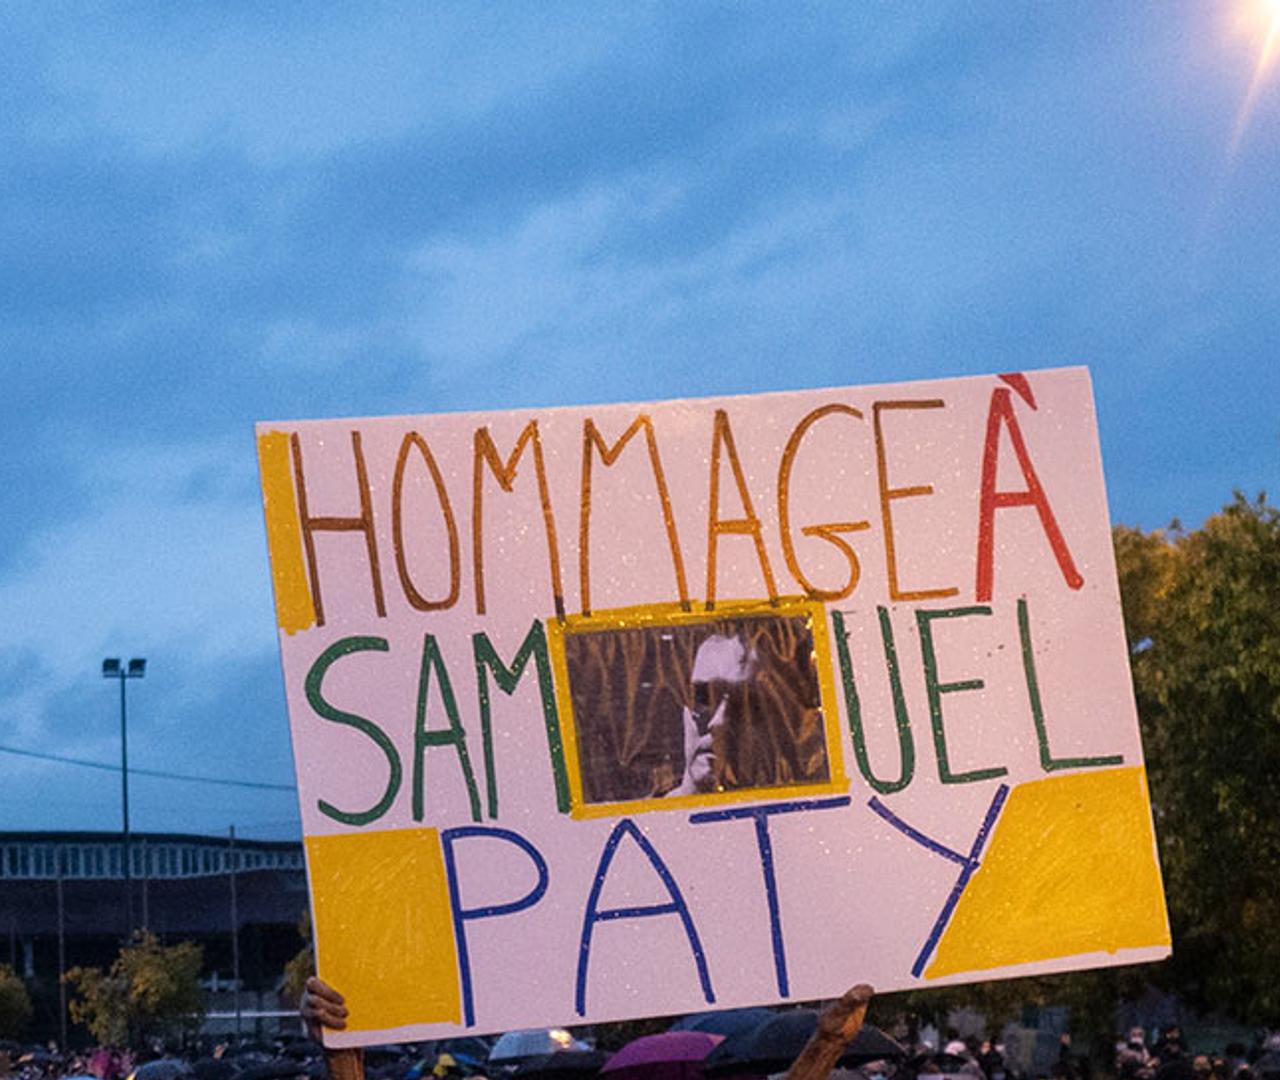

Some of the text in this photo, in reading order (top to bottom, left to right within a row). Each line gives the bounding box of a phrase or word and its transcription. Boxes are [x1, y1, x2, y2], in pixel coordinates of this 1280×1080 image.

[289, 371, 1085, 627] HOMMAGE À
[439, 783, 1010, 1027] PATY
